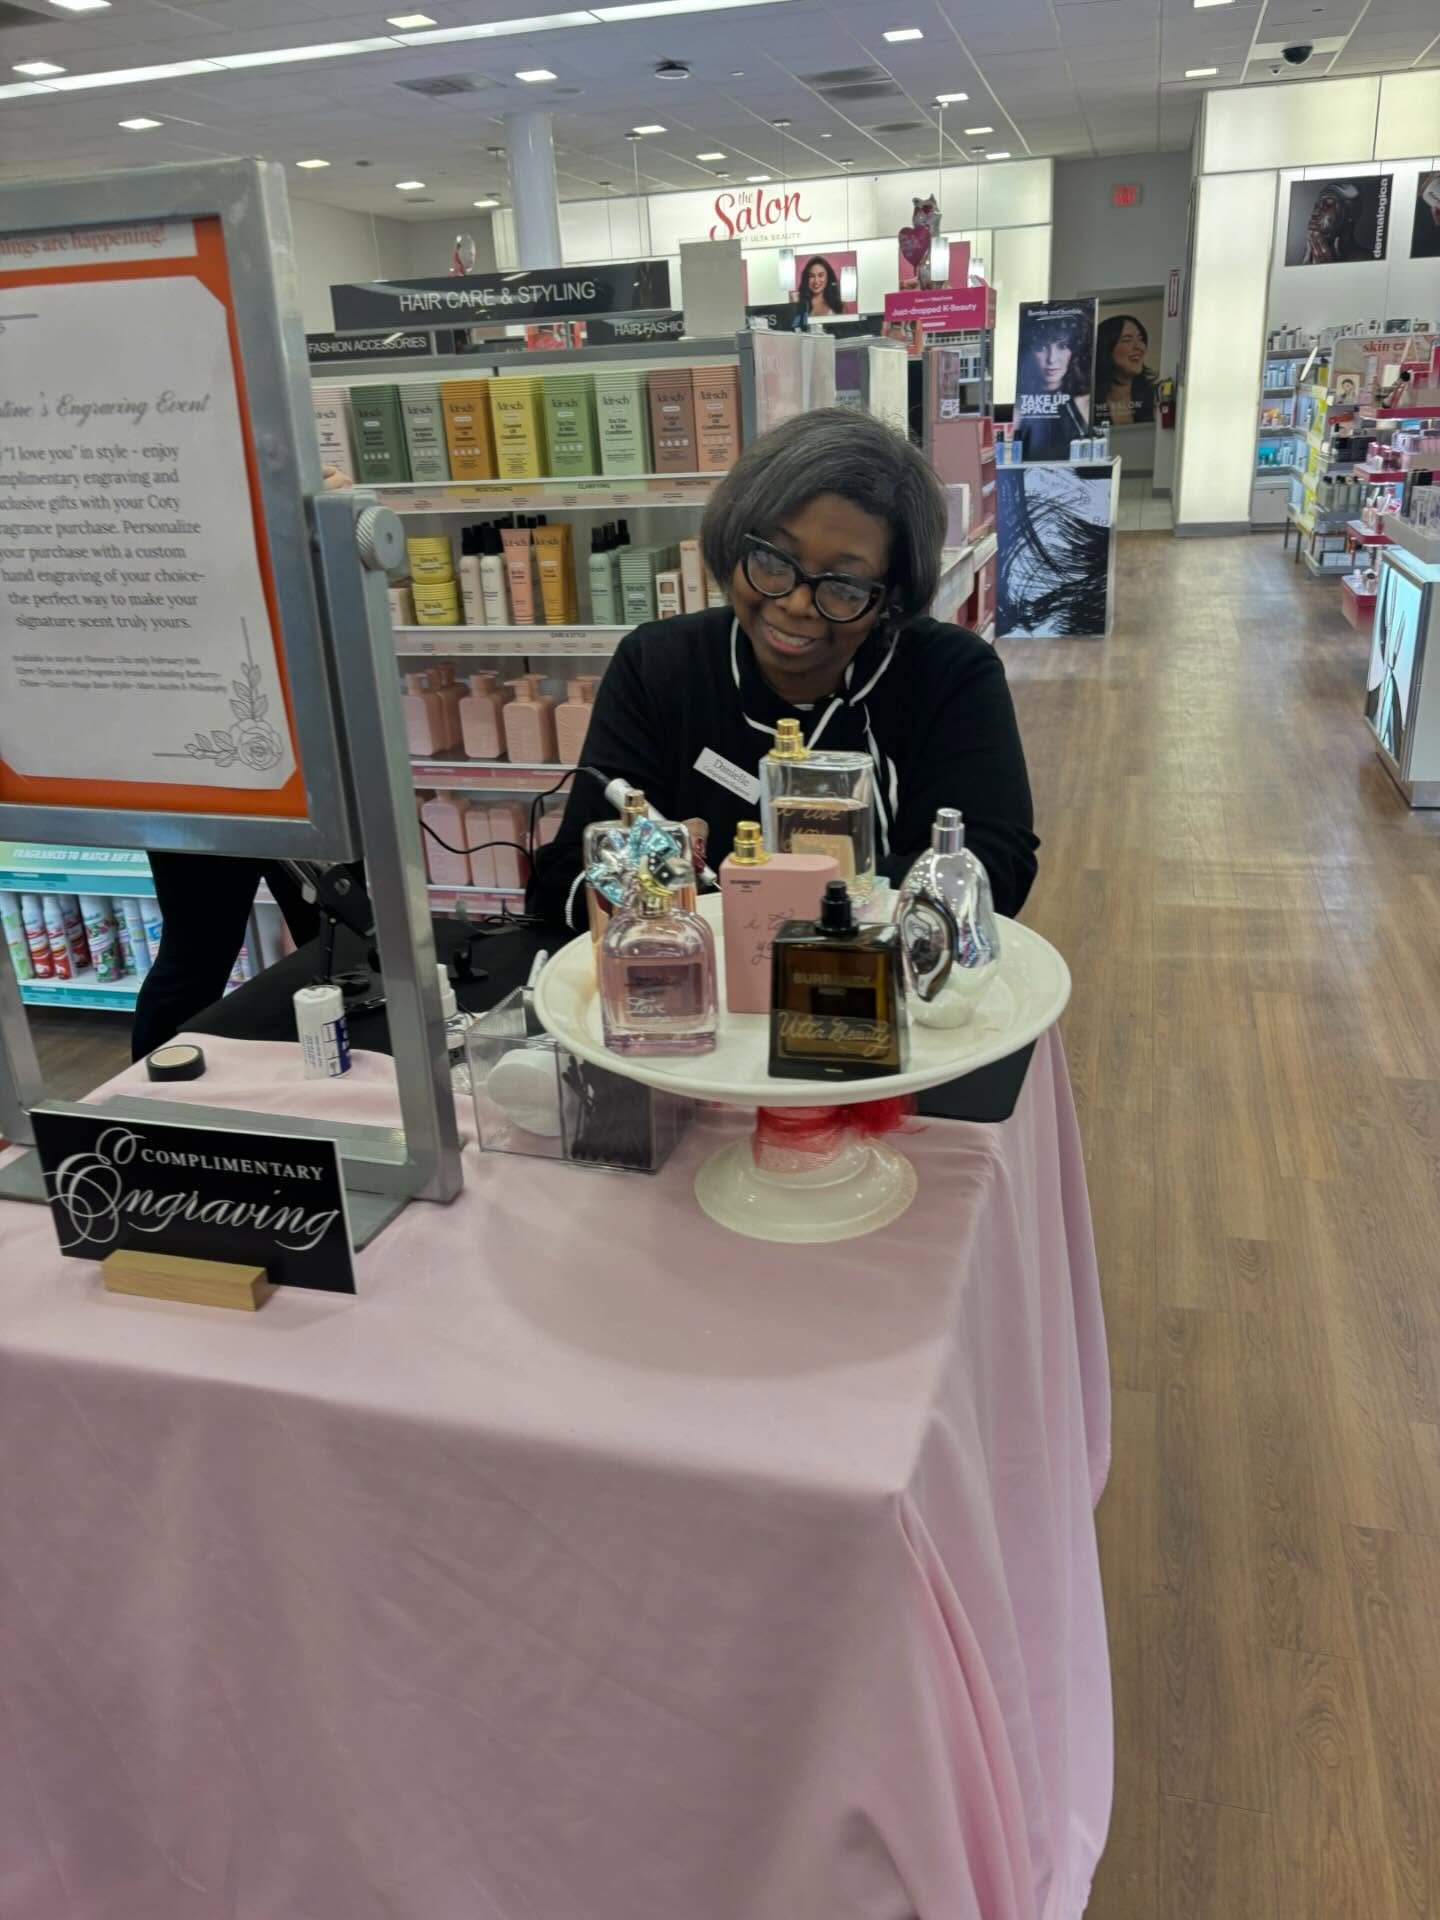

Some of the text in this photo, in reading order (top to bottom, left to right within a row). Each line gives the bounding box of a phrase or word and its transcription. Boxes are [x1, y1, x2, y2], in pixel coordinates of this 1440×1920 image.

[738, 192, 752, 206] the
[709, 188, 812, 241] Salon
[1373, 177, 1389, 259] dermalogica
[770, 232, 801, 241] BEAUTY
[399, 280, 597, 312] HAIR CARE & STYLING
[613, 322, 640, 337] HAIR
[308, 336, 427, 355] FASHION ACCESSORIES
[1362, 340, 1390, 352] skin
[56, 392, 148, 428] Engraving
[156, 389, 212, 415] Event
[1020, 394, 1051, 406] TAKE
[1020, 403, 1059, 414] SPACE
[18, 445, 45, 461] love
[80, 445, 94, 459] in
[96, 443, 128, 463] style
[142, 443, 180, 462] enjoy
[83, 469, 153, 488] engraving
[153, 468, 180, 483] and
[49, 494, 79, 514] gifts
[80, 494, 111, 510] with
[112, 497, 145, 515] your
[147, 494, 181, 512] Coty
[56, 520, 120, 538] purchase.
[123, 519, 202, 535] Personalize
[30, 545, 89, 563] purchase
[90, 544, 121, 559] with
[124, 547, 134, 559] a
[136, 546, 188, 560] custom
[1, 568, 35, 583] hand
[37, 569, 104, 587] engraving
[104, 568, 119, 582] of
[120, 571, 152, 587] your
[8, 591, 199, 610] the perfect way to make your
[15, 613, 193, 632] signature scent truly yours.
[140, 1148, 324, 1182] COMPLIMENTARY
[43, 1127, 340, 1251] Engraving
